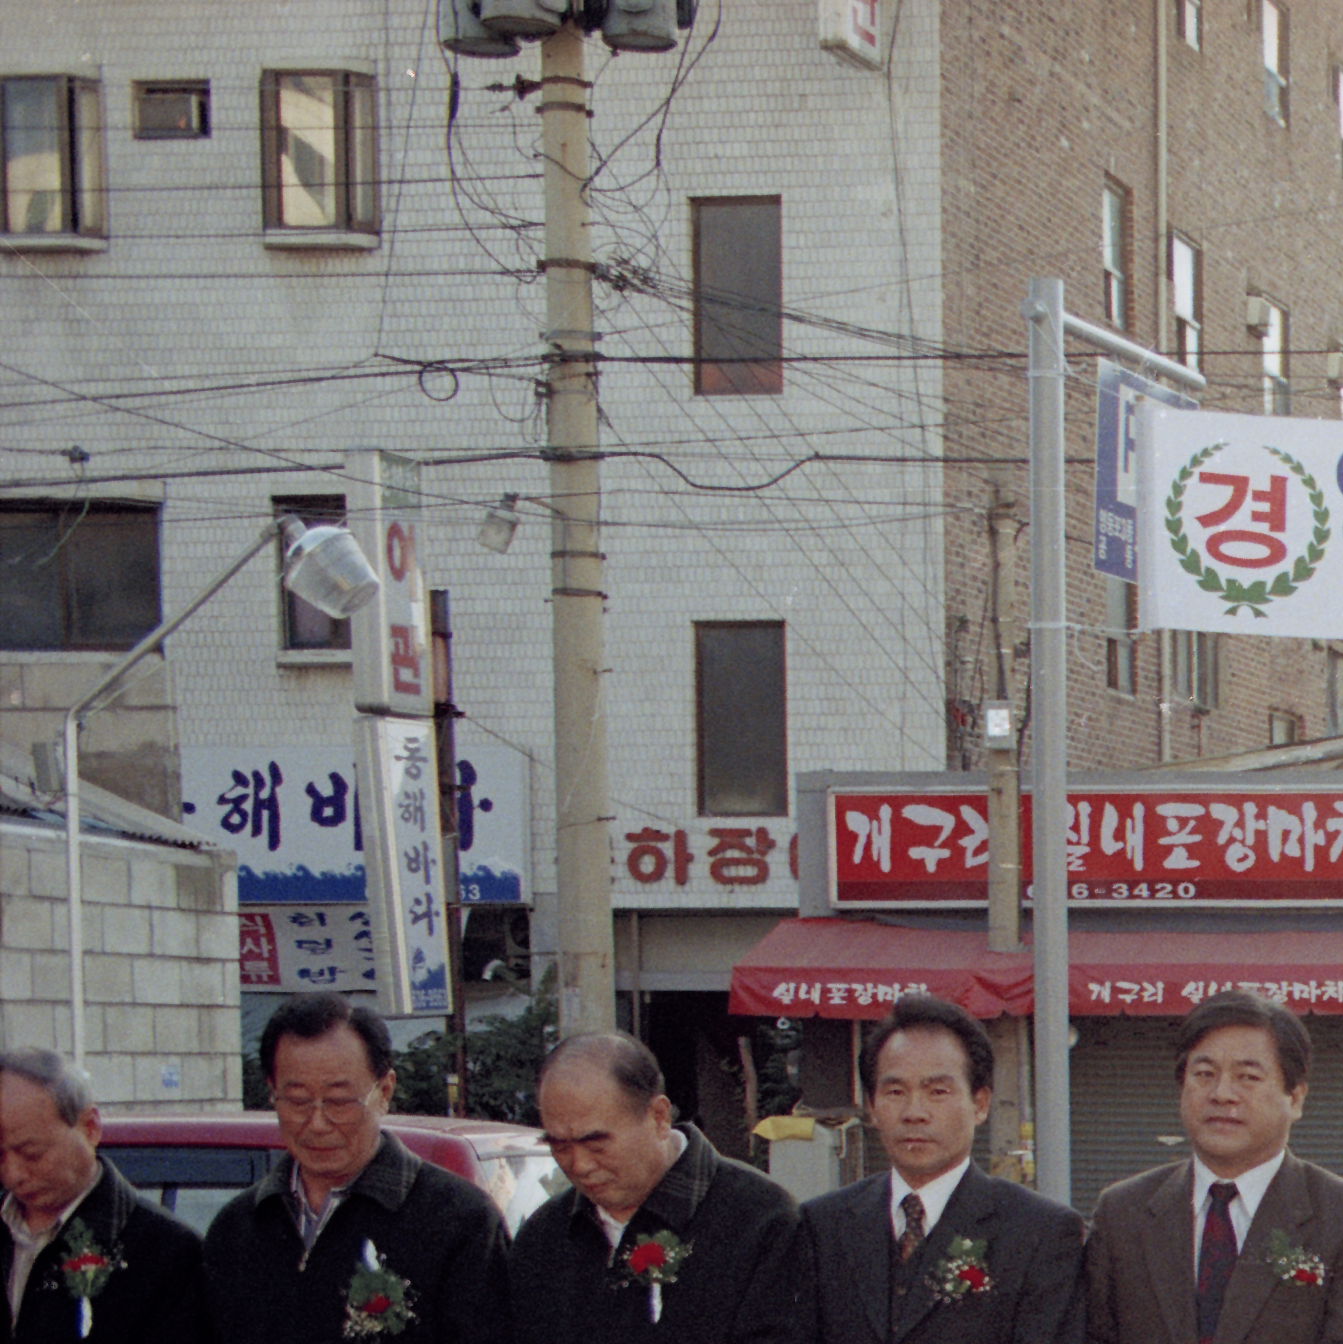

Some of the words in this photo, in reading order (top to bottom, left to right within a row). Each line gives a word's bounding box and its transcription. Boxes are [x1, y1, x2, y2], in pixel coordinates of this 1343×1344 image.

[1196, 471, 1288, 569] 경
[609, 826, 797, 886] 하장
[1027, 882, 1197, 900] 6-3420
[1087, 982, 1166, 1004] 개구리
